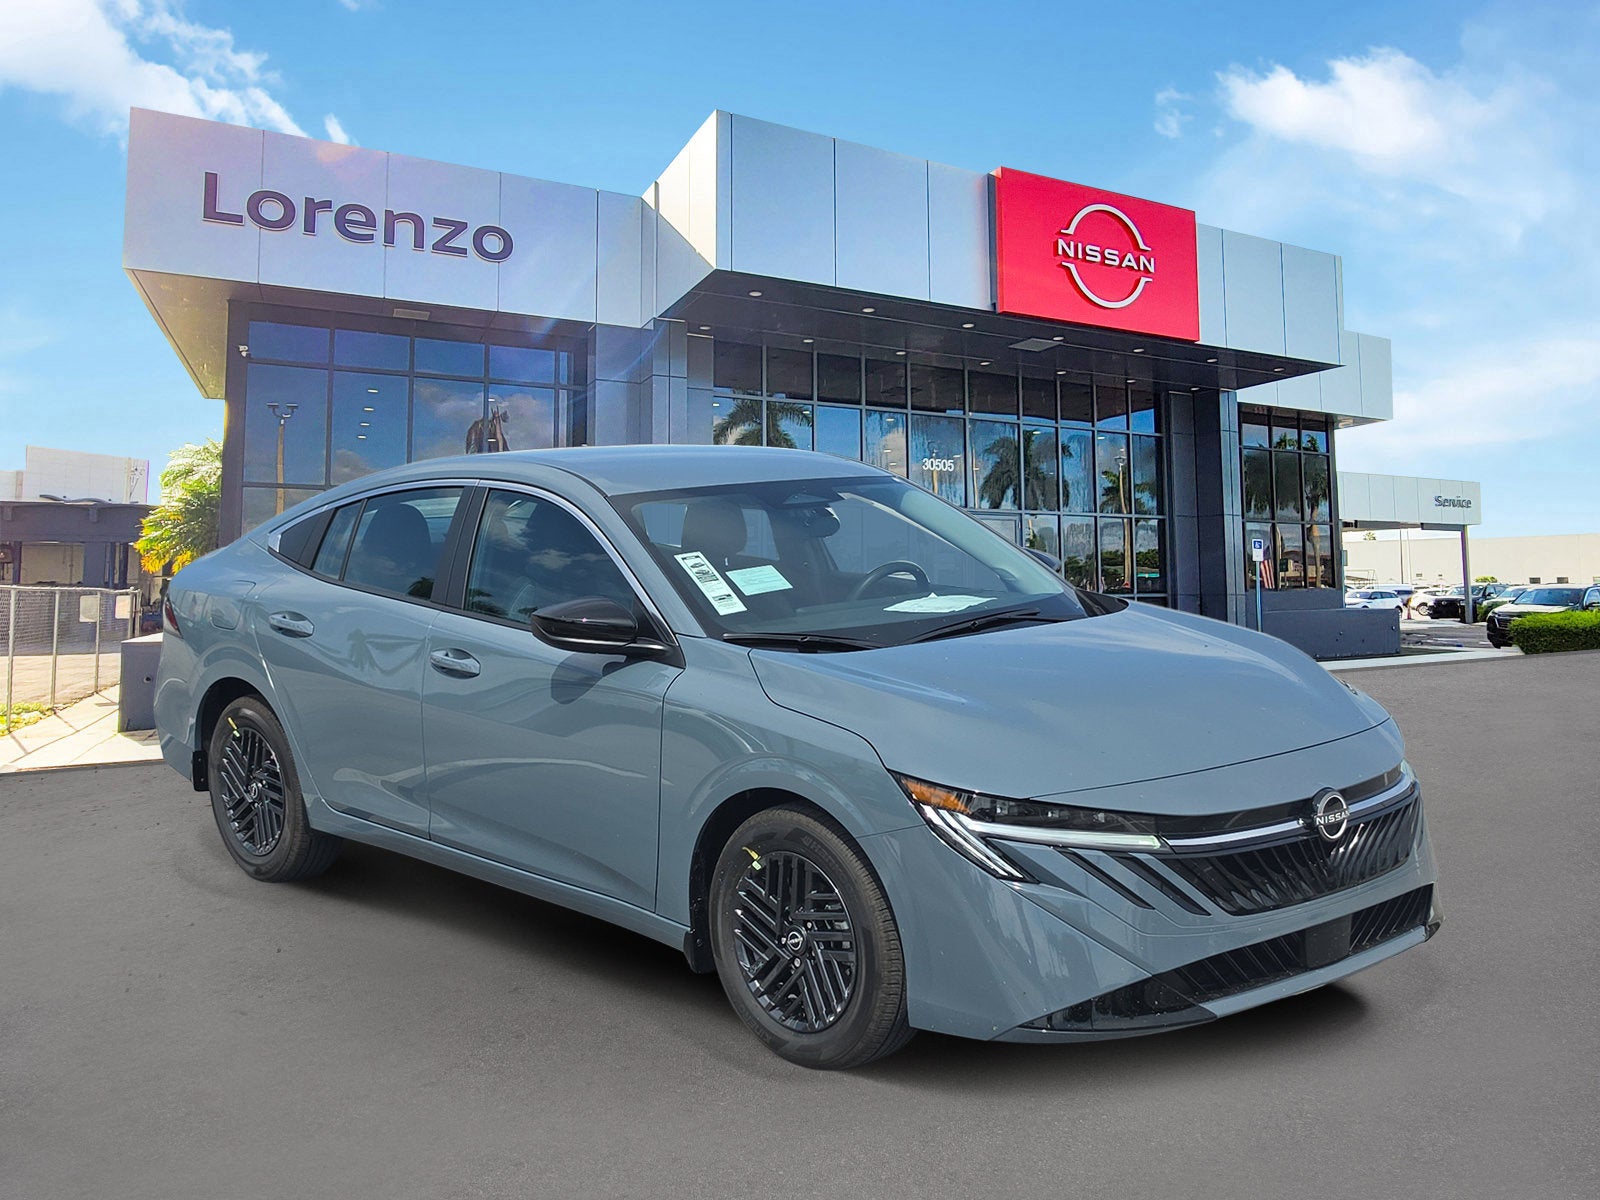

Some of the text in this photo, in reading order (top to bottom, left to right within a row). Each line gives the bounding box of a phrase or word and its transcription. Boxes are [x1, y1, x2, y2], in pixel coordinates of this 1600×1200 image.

[202, 171, 514, 263] Lorenzo
[1057, 238, 1155, 273] NISSAN
[922, 457, 955, 472] 30505
[1434, 495, 1472, 509] Service
